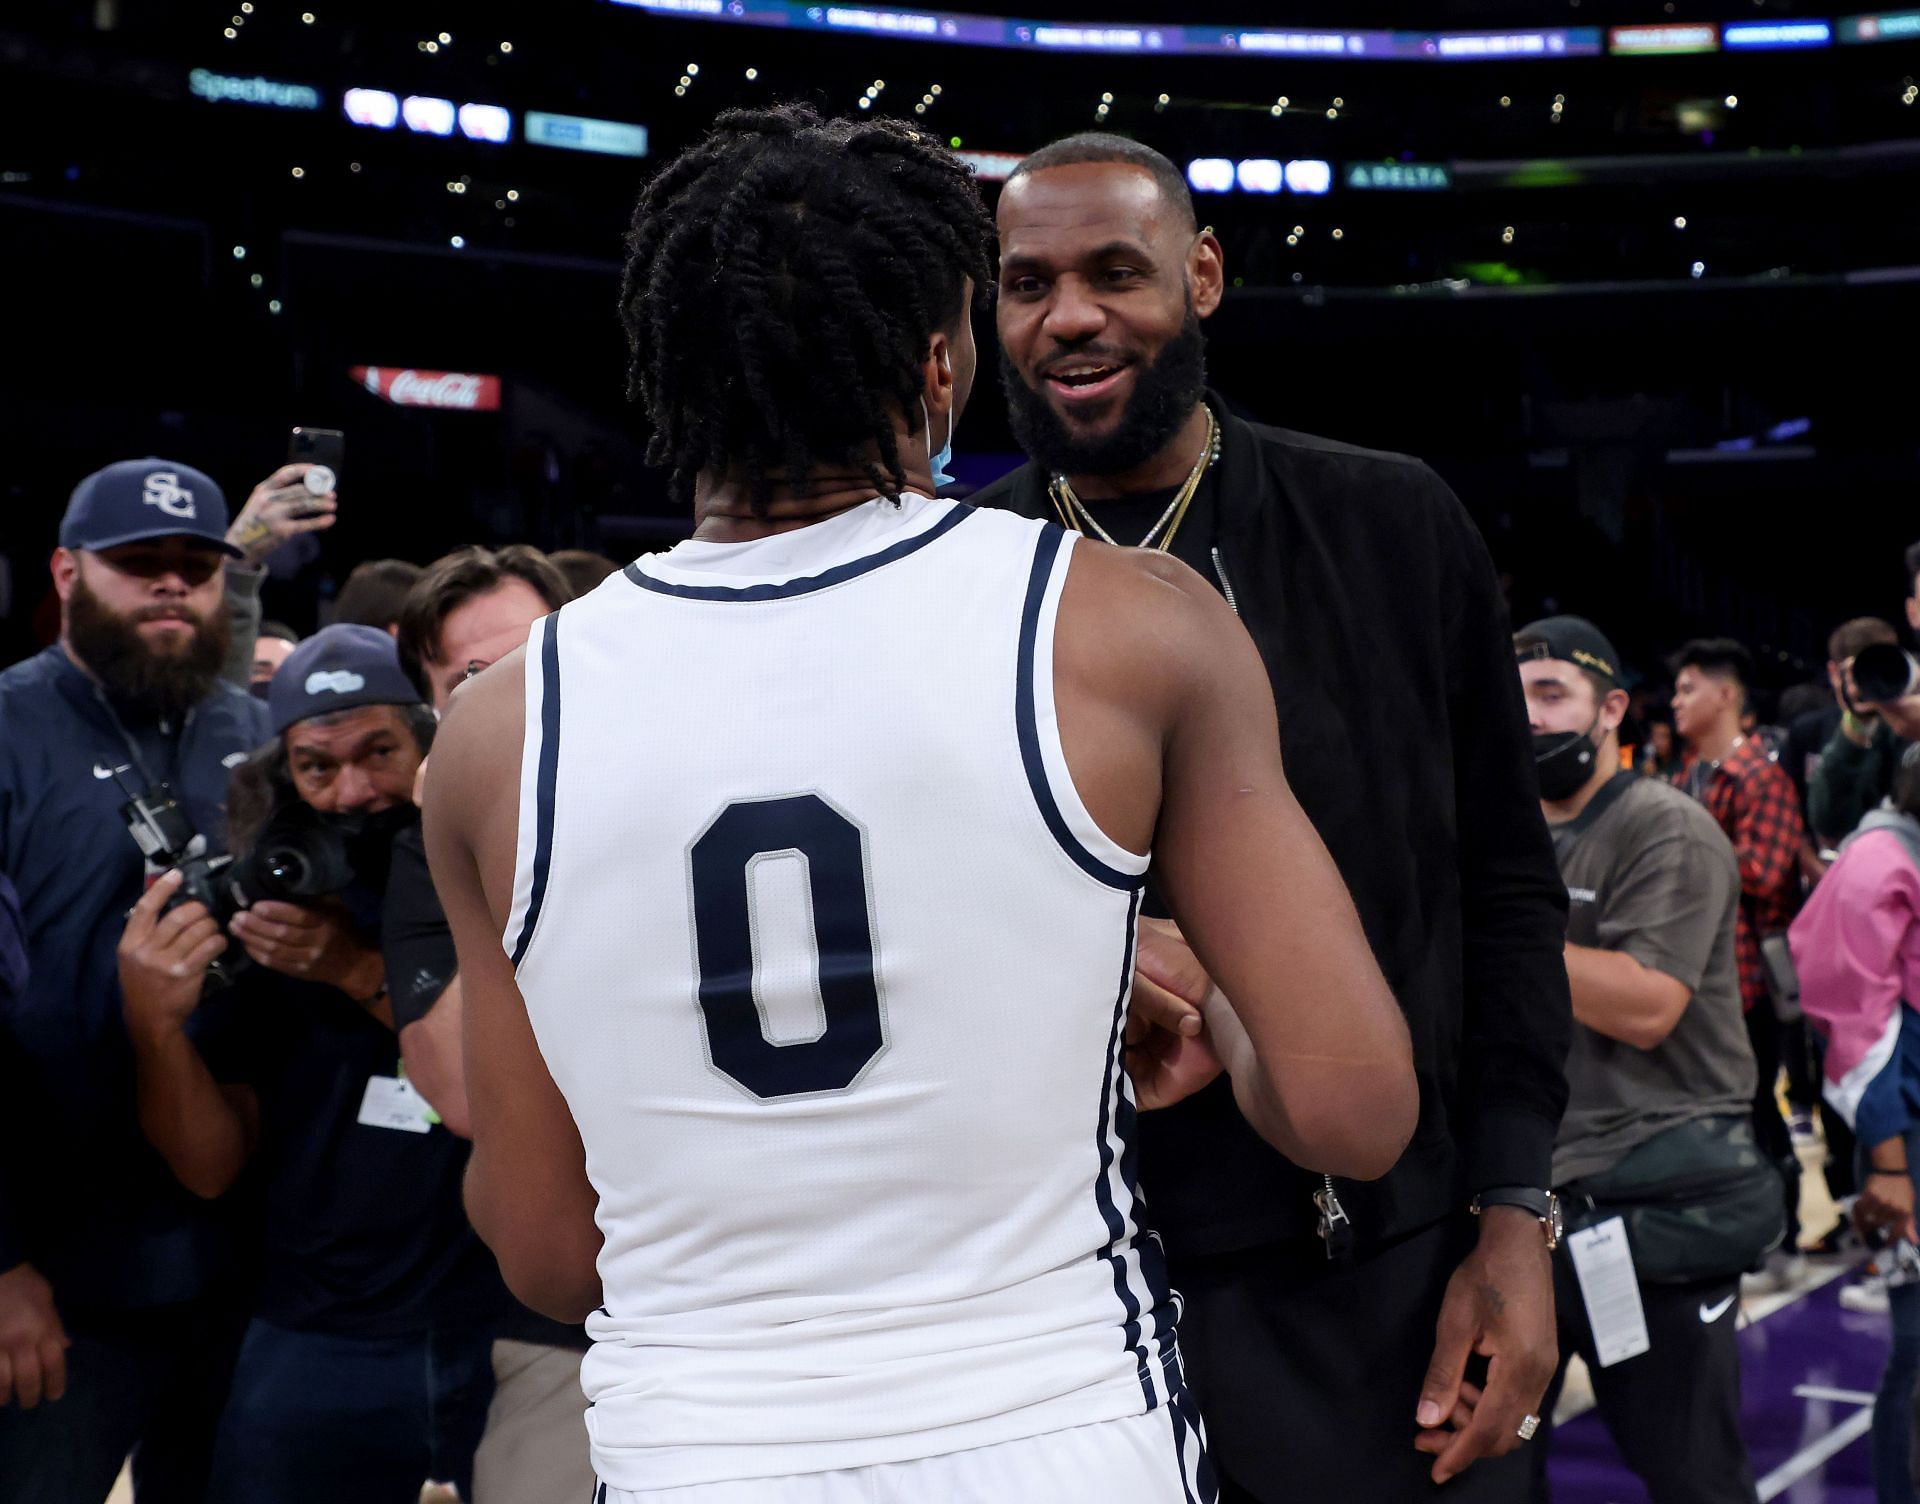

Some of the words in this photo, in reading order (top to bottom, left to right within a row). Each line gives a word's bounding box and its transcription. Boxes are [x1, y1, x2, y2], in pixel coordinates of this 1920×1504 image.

[189, 68, 317, 110] Spectrum
[1371, 165, 1448, 187] DELTA
[142, 471, 196, 520] SC
[684, 788, 892, 1106] 0
